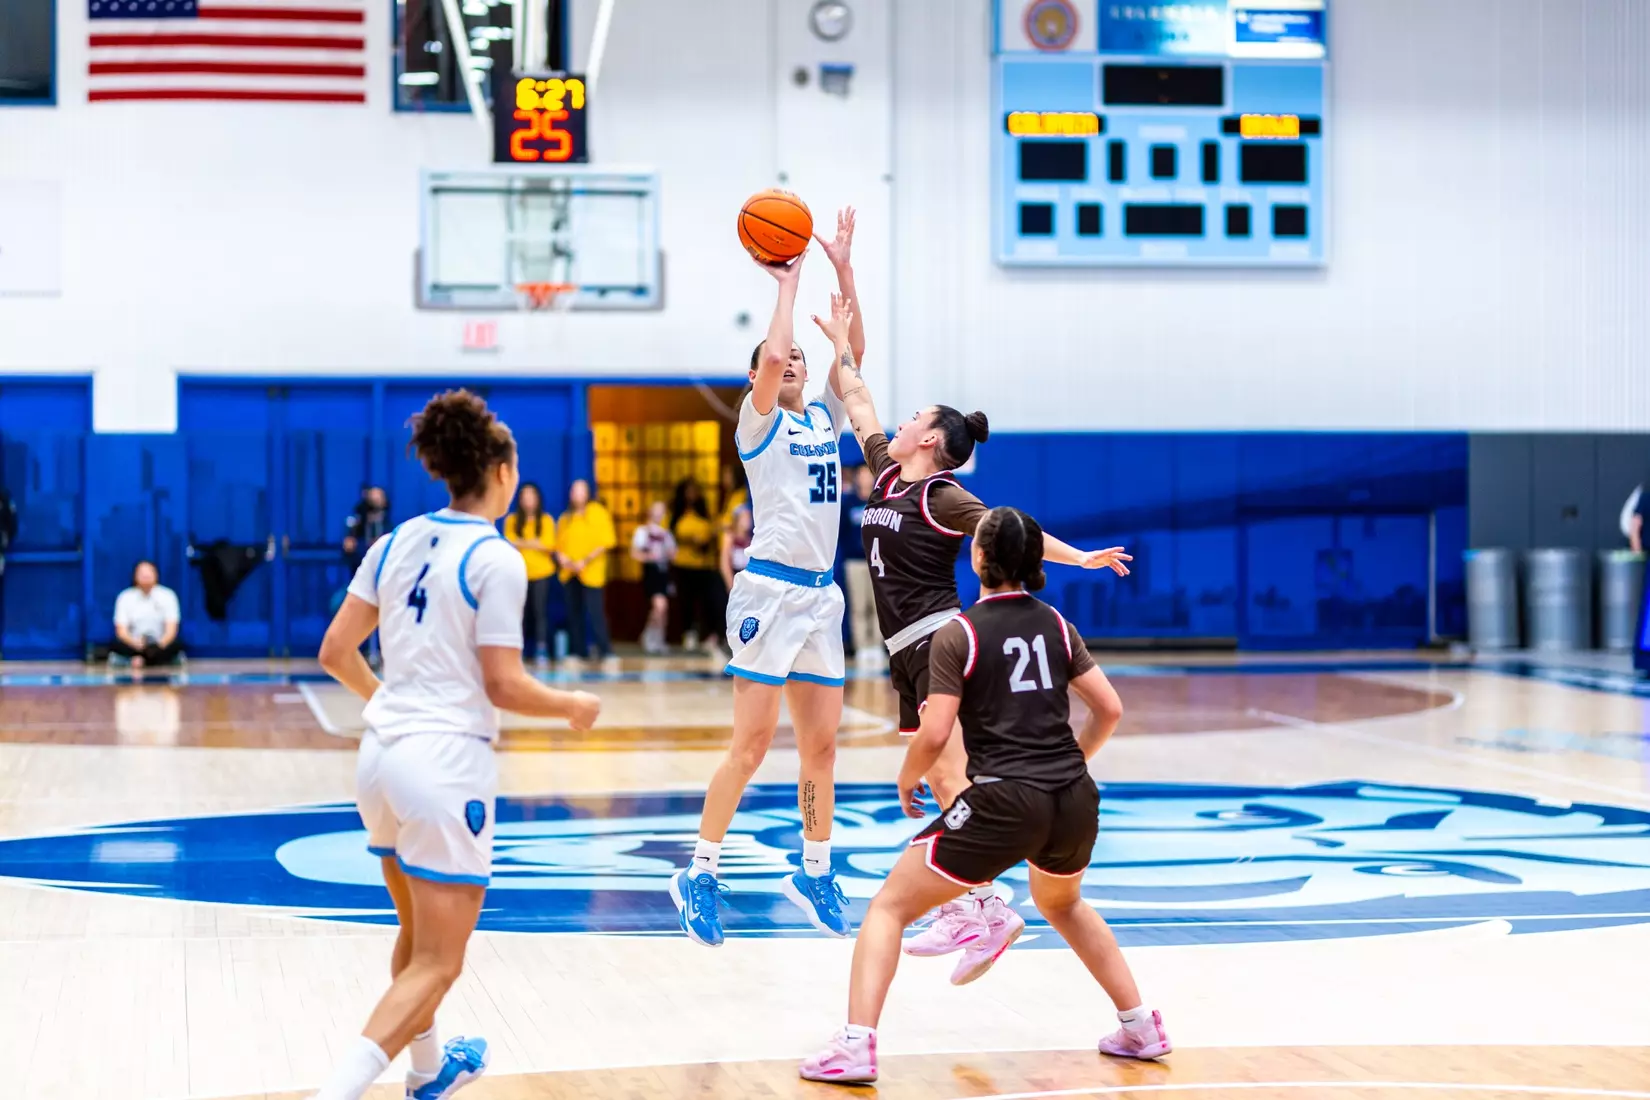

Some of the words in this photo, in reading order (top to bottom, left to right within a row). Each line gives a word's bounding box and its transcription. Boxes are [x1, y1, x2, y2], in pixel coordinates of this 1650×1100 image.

[516, 77, 585, 111] 6:27
[510, 109, 573, 162] 25
[808, 462, 838, 504] 35
[870, 537, 886, 577] 4
[407, 563, 431, 624] 4
[814, 574, 824, 587] C
[1002, 634, 1054, 693] 21
